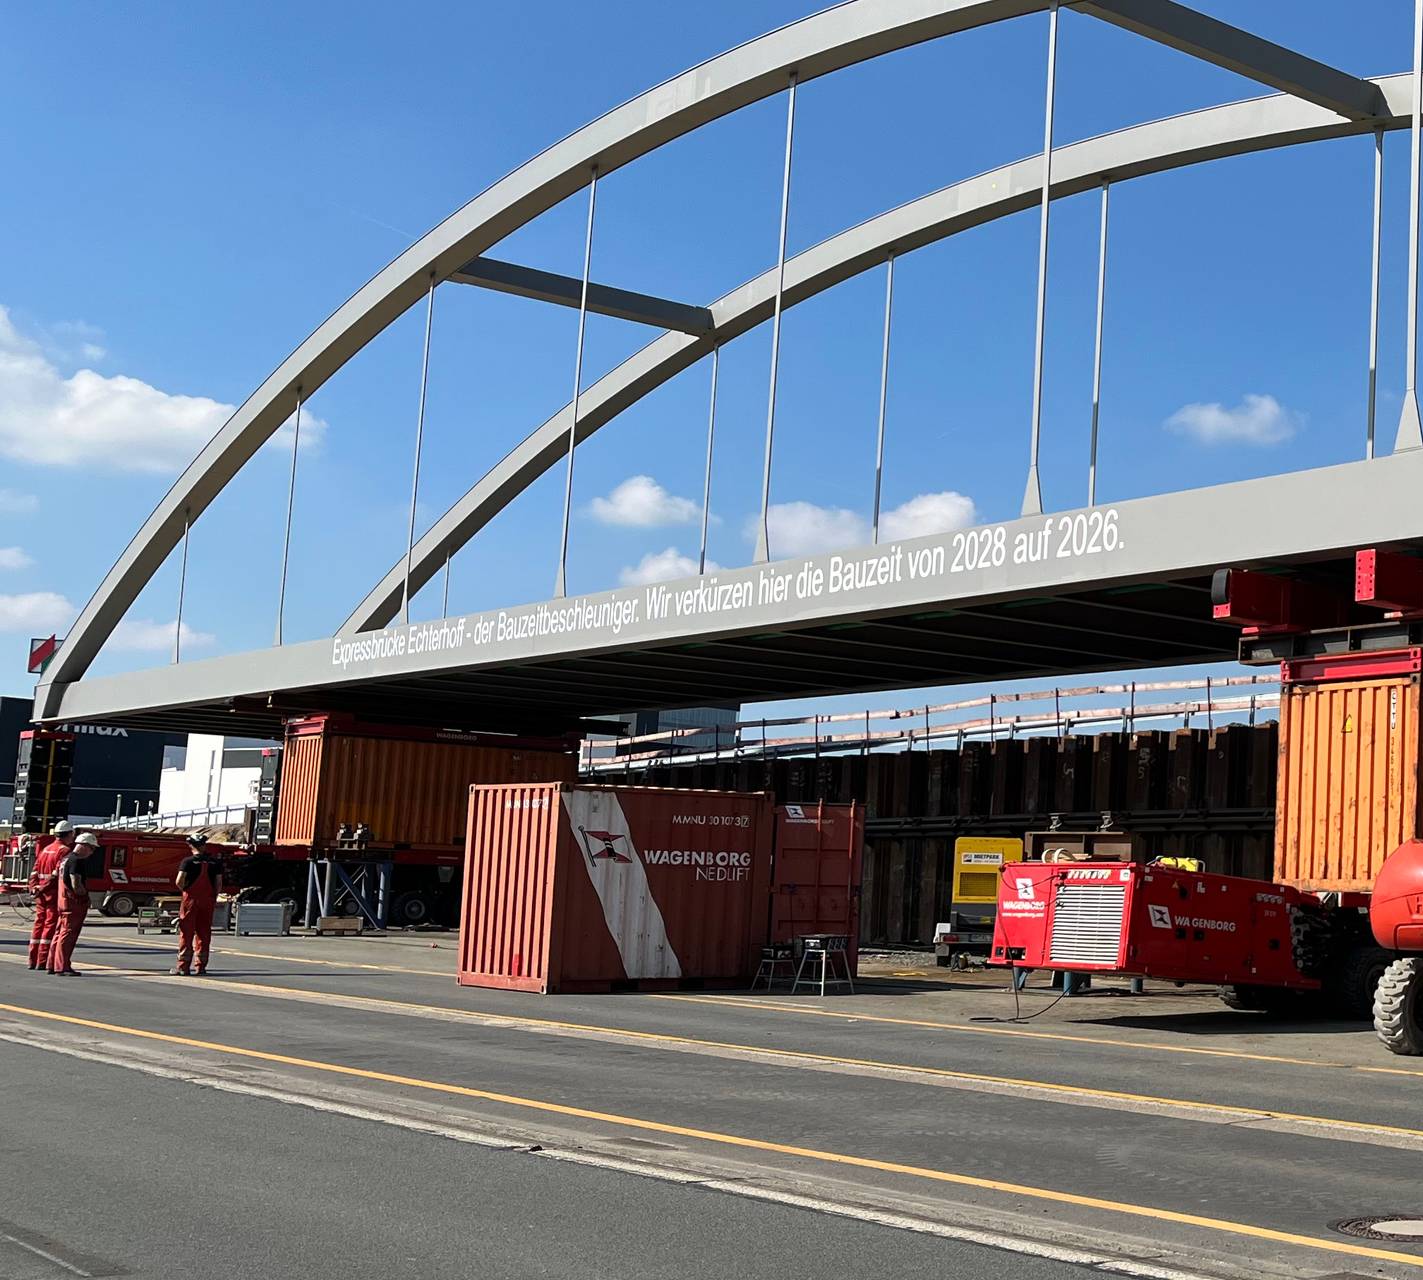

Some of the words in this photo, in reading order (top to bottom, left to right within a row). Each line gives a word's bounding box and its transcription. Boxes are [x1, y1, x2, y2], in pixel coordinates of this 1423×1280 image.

[332, 630, 406, 670] Expressbrücke
[408, 618, 466, 654] Echterhoff
[474, 615, 495, 645] der
[497, 594, 640, 642] Bauzeitbeschleuniger.
[646, 585, 673, 620] Wir
[676, 577, 753, 617] verkürzen
[759, 568, 793, 605] hier
[796, 561, 824, 599] die
[828, 545, 904, 592] Bauzeit
[908, 546, 945, 579] von
[950, 526, 1007, 573] 2028
[1013, 518, 1054, 564] auf
[1056, 509, 1125, 558] 2026.
[672, 815, 706, 825] MMNU
[644, 850, 751, 866] WAGENBORG
[695, 866, 751, 881] NEDLIFT
[1174, 915, 1237, 932] WAGENBORG
